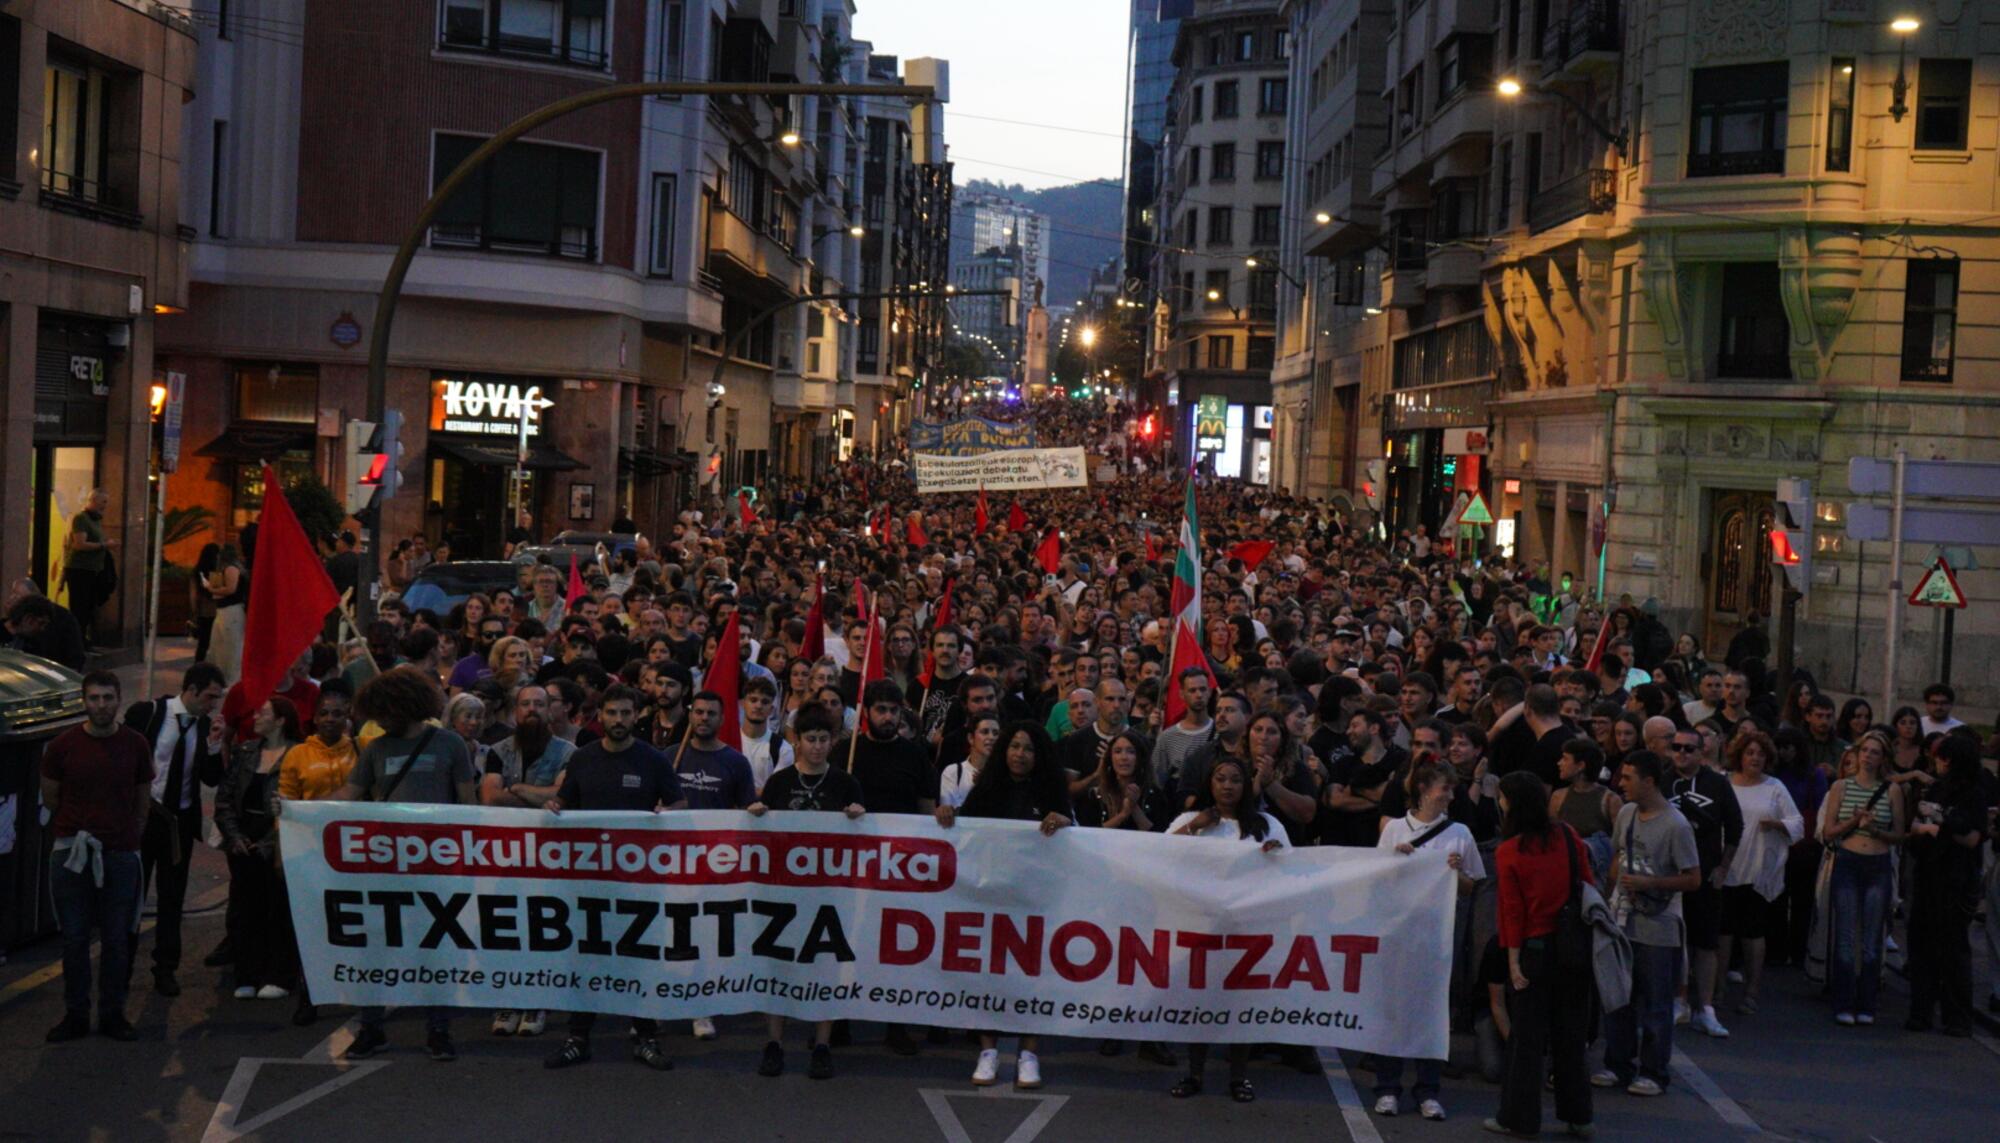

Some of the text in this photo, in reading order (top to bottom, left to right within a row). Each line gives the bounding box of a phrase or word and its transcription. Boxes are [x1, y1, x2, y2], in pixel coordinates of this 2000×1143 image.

[446, 381, 540, 420] KOVAC
[339, 825, 940, 882] Espekulazioaren aurka
[324, 889, 1379, 993] ETXEBIZITZA DENONTZAT
[334, 964, 1364, 1030] Etxegabetze guztiak eten, espekulatzaileak espropiatu eta espekulazioa debekatu.
